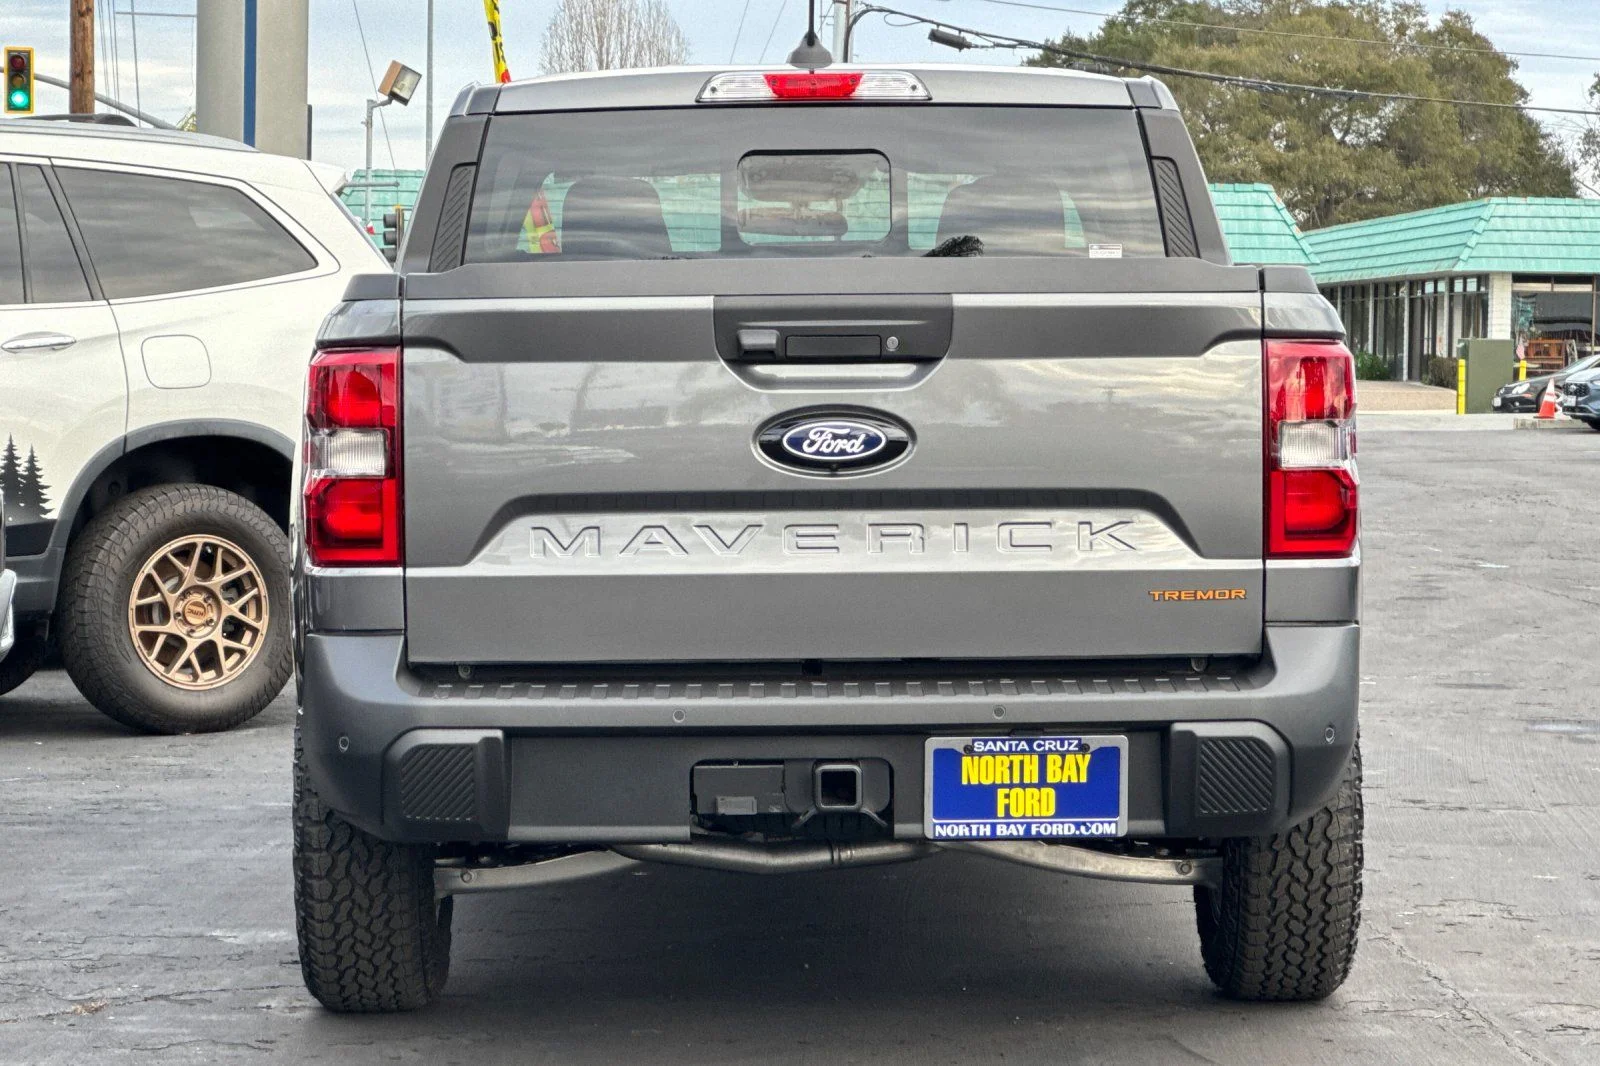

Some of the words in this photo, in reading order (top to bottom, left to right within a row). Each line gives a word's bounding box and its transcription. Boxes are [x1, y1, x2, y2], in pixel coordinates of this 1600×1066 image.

[802, 427, 865, 453] Ford
[529, 519, 1137, 559] MAVERICK
[1148, 588, 1248, 602] TREMOR
[973, 740, 1029, 752] SANTA
[1032, 739, 1079, 751] CRUZ
[961, 754, 1039, 785] NORTH
[1046, 754, 1091, 783] BAY
[996, 787, 1056, 817] FORD
[935, 823, 991, 837] NORTH
[996, 823, 1027, 836] BAY
[1031, 822, 1116, 836] FORD.COM
